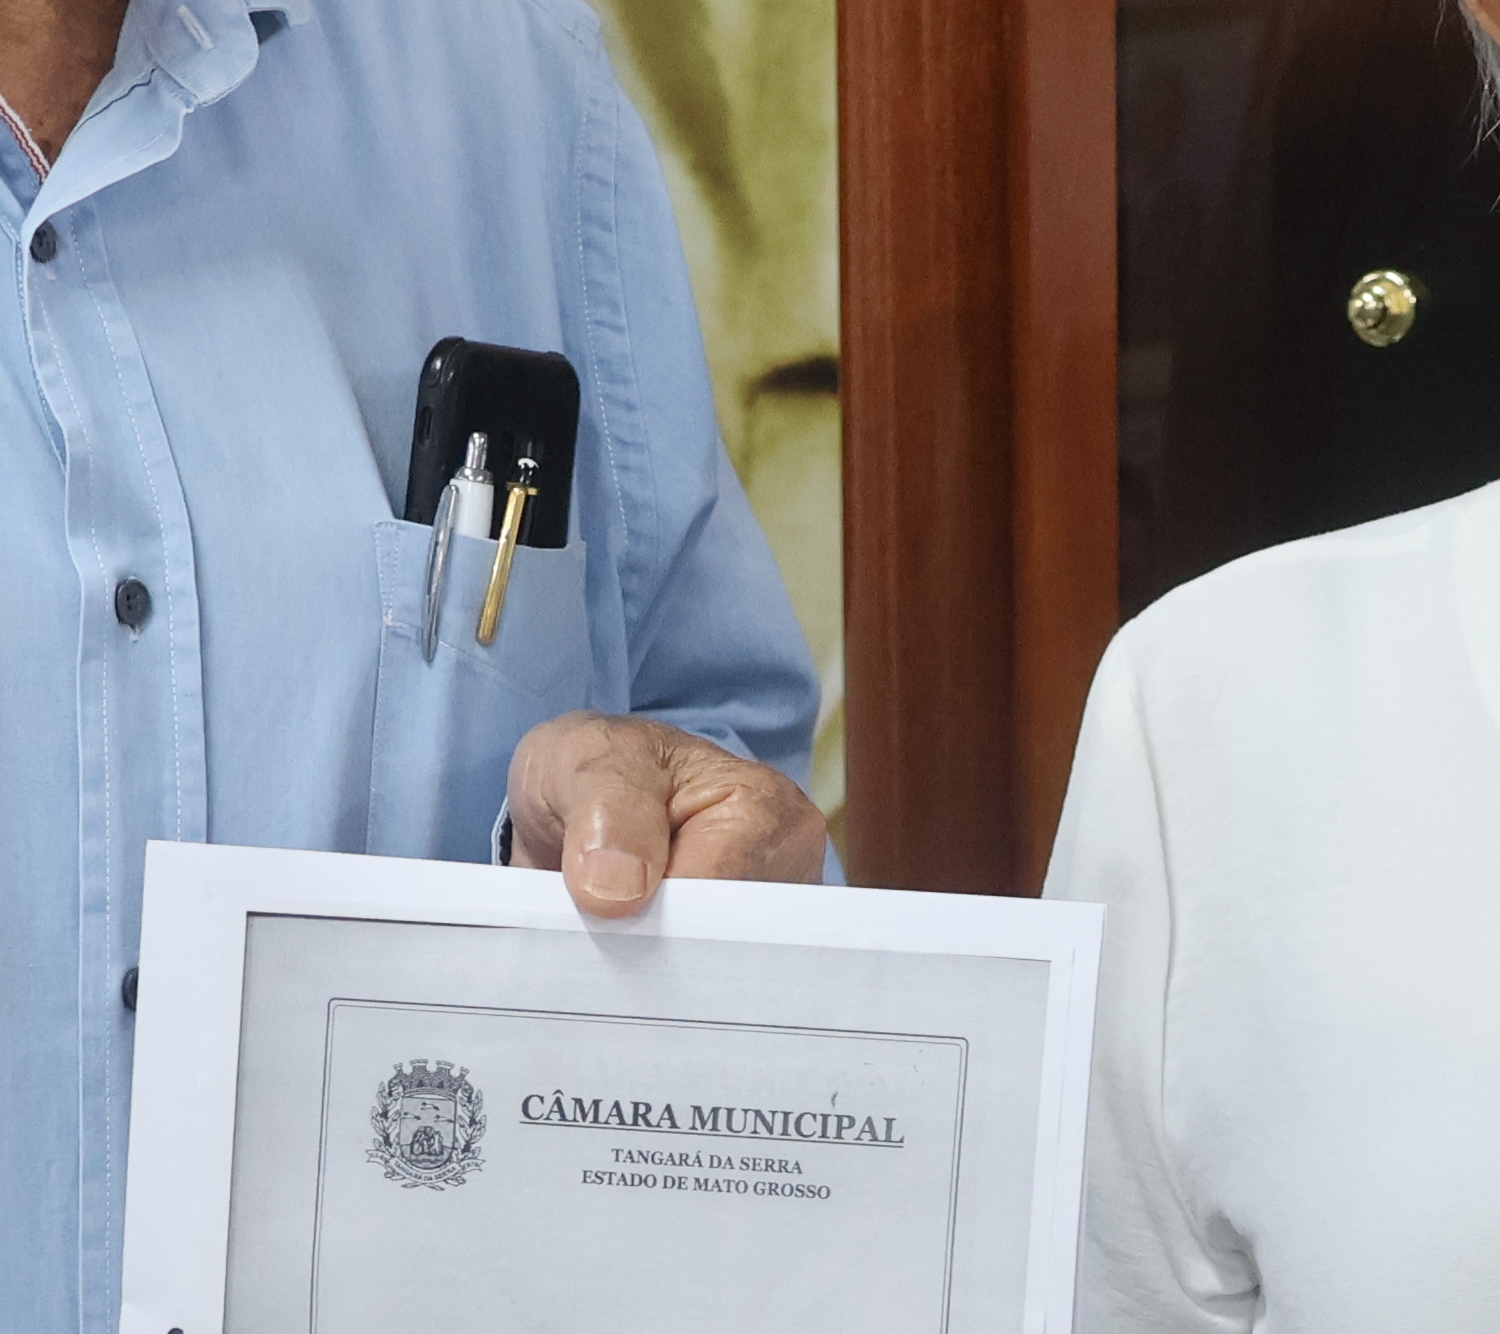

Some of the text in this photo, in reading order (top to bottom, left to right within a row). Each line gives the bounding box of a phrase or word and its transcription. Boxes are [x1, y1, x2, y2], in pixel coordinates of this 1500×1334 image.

[521, 1089, 905, 1144] CÂMARA MUNICIPAL
[611, 1148, 803, 1174] TANGARÁ DA SERRA
[581, 1170, 831, 1200] ESTADO DE MATO GROSSO
